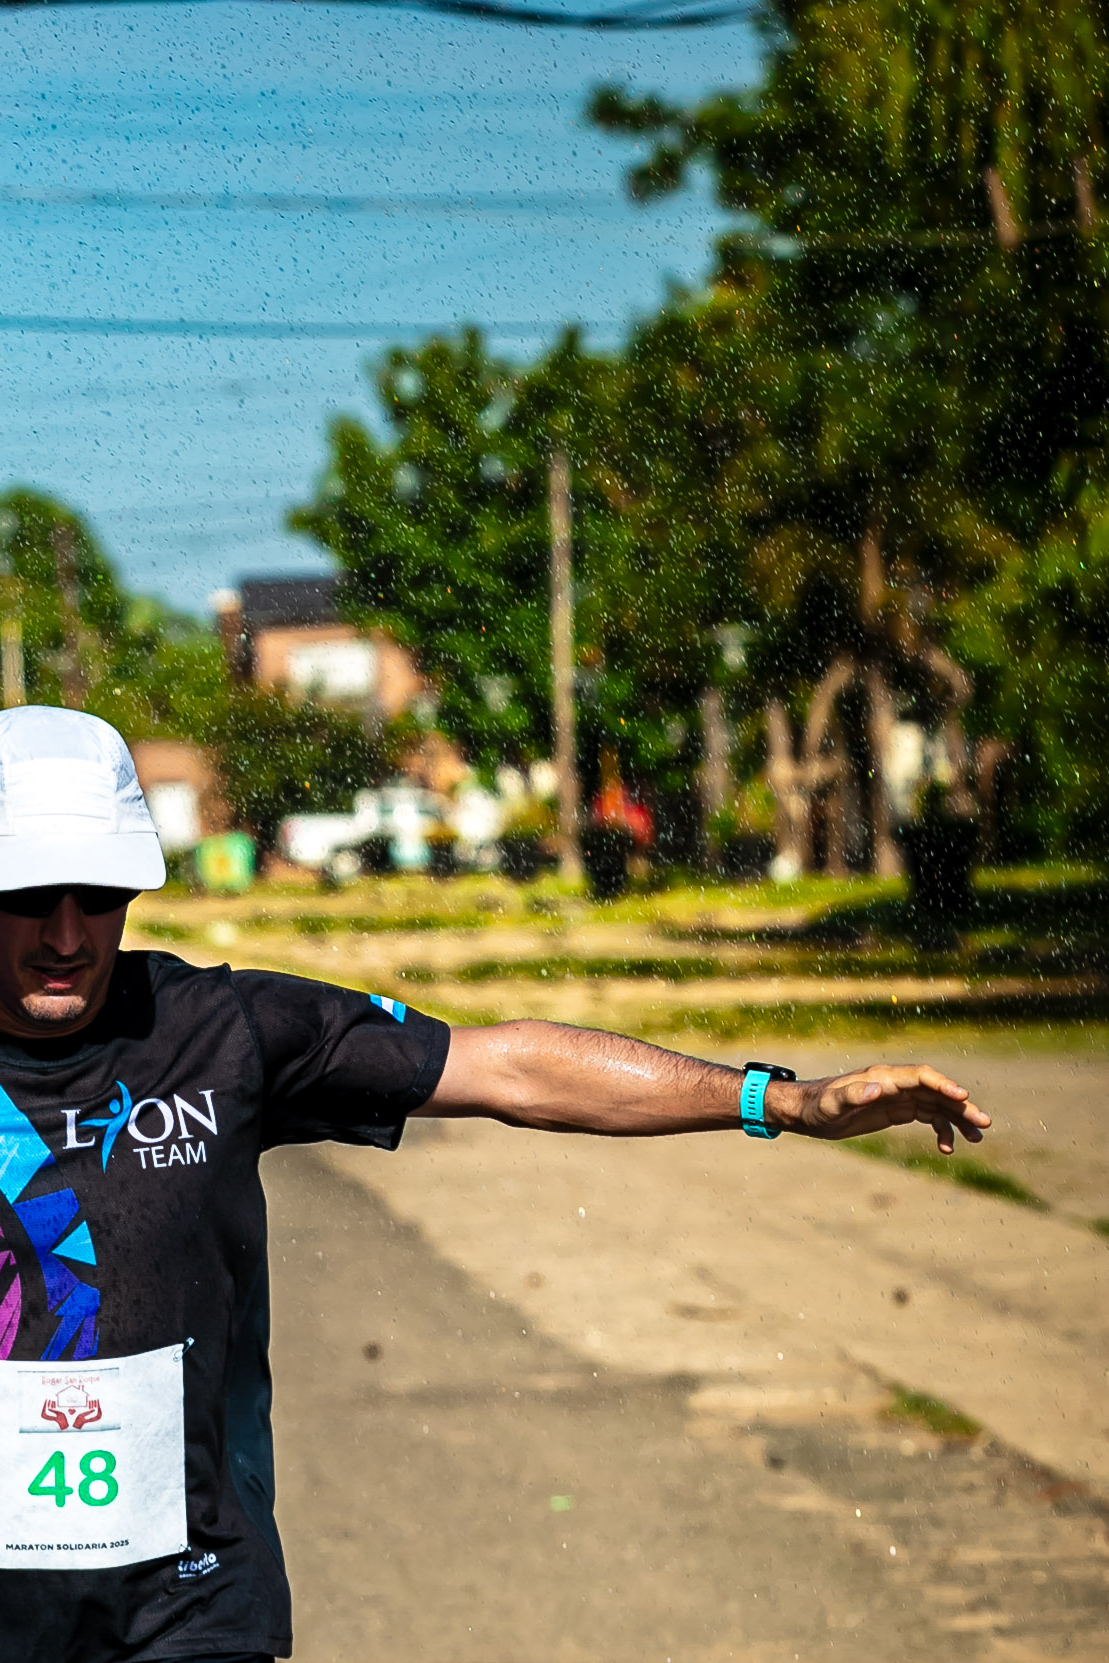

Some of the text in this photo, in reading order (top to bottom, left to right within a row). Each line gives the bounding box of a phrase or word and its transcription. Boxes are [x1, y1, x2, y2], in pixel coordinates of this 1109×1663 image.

[132, 1140, 207, 1170] TEAM
[28, 1450, 119, 1508] 48
[5, 1539, 130, 1551] MARATON SOLIDARIA 2025
